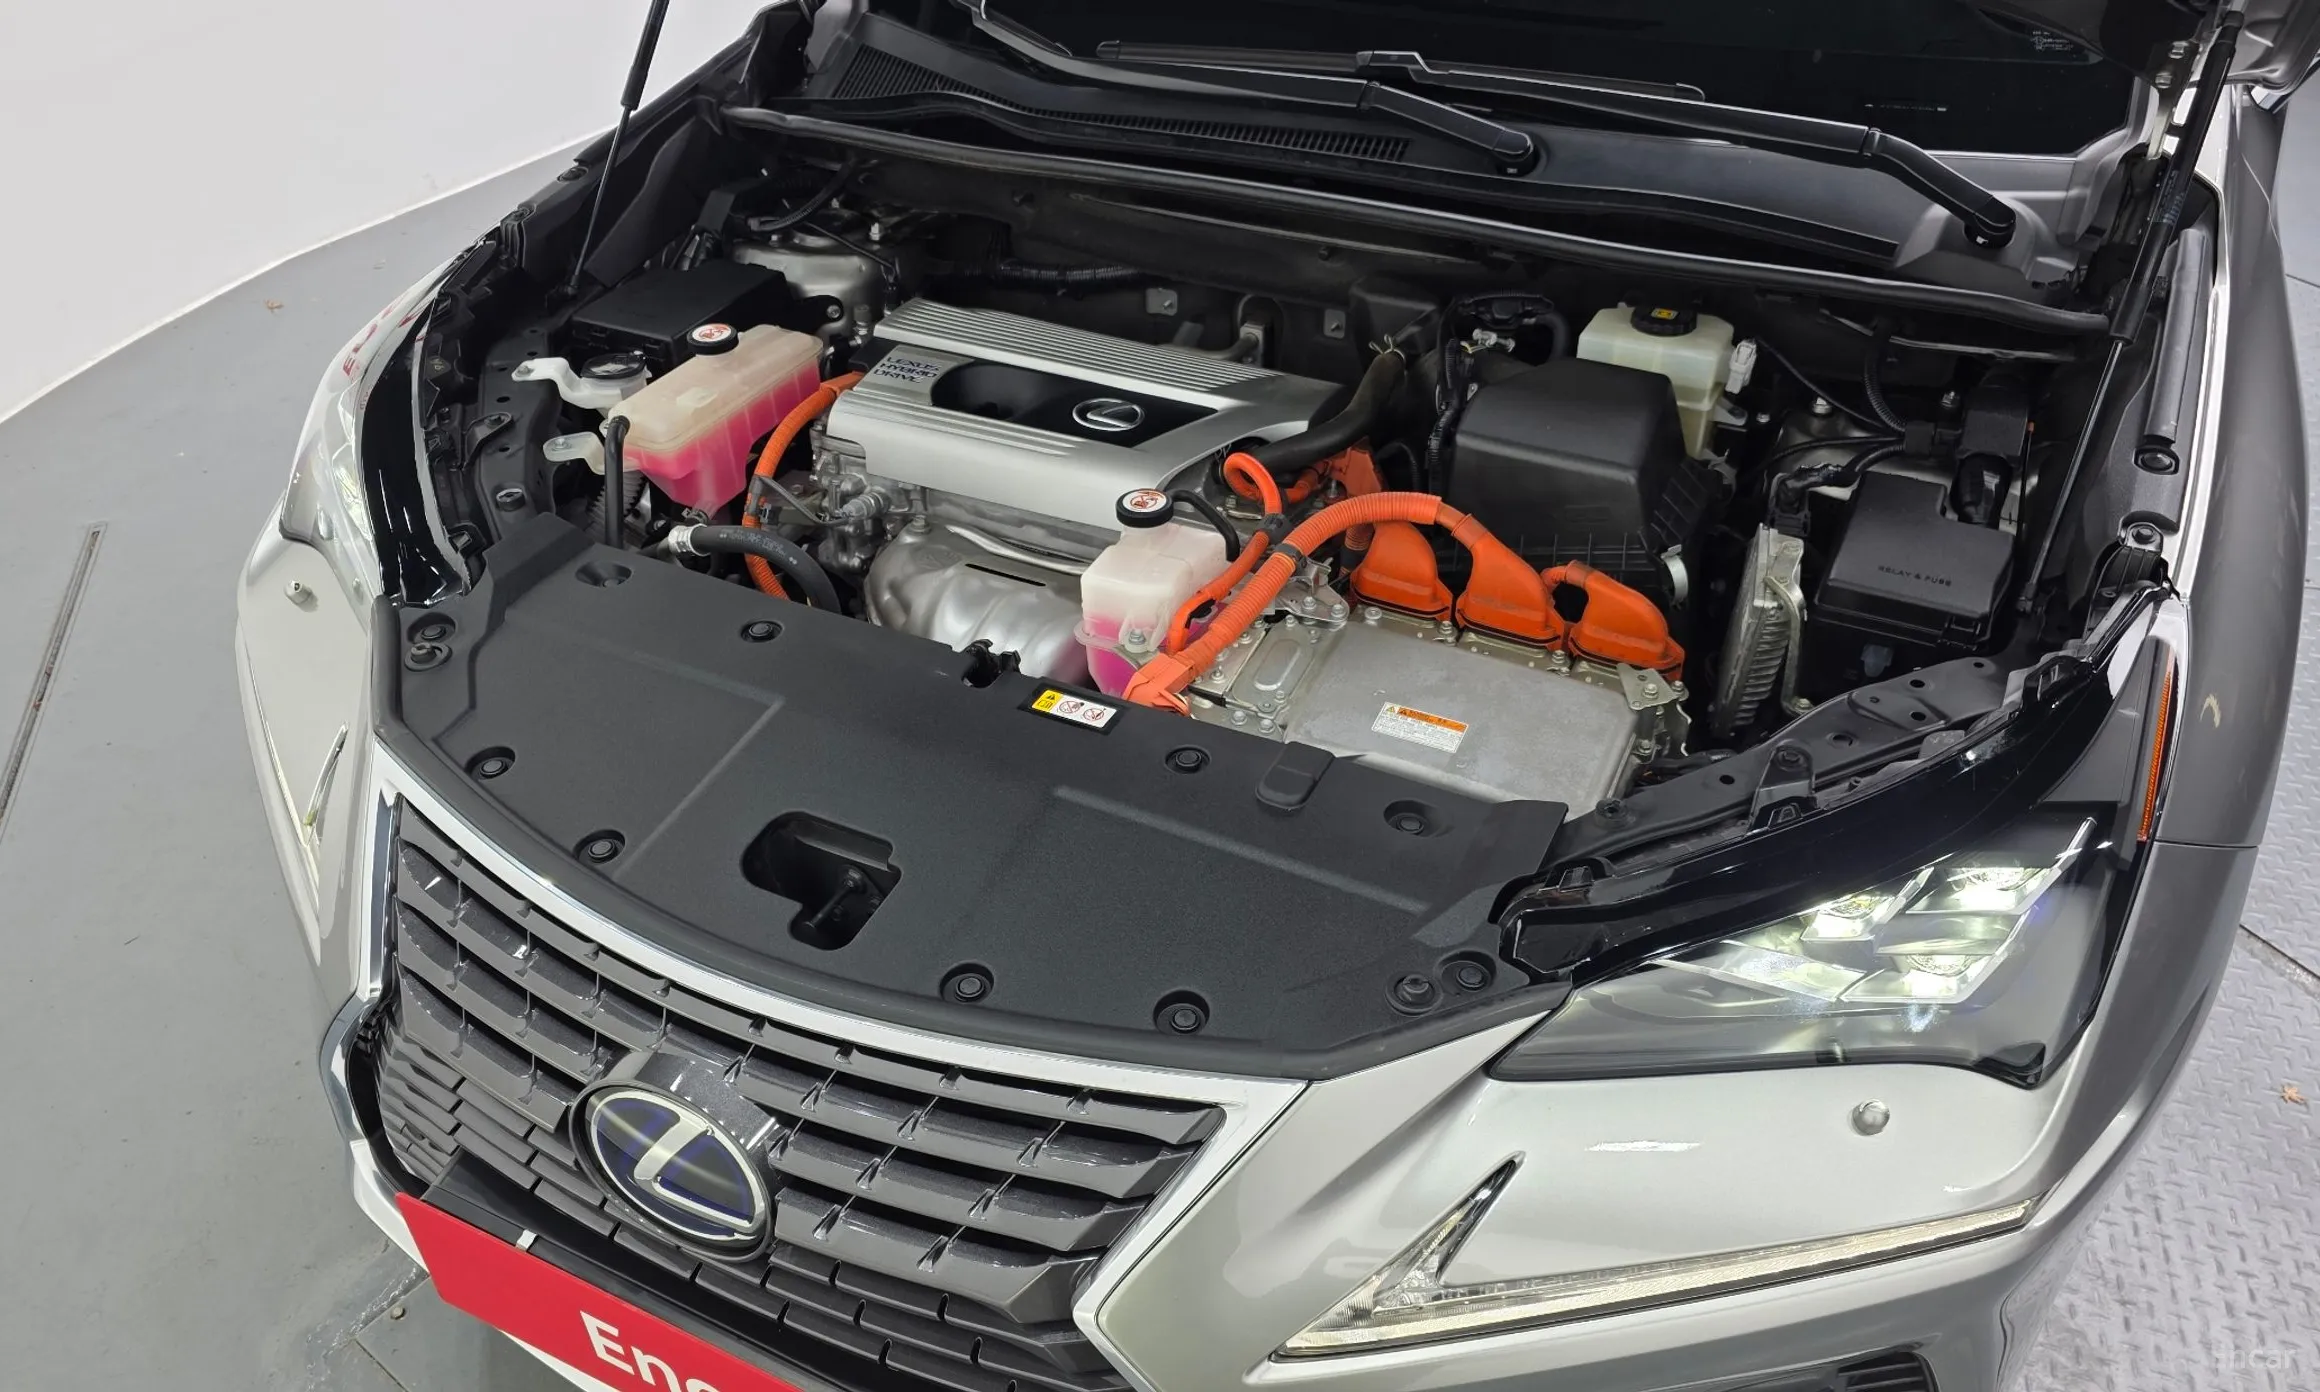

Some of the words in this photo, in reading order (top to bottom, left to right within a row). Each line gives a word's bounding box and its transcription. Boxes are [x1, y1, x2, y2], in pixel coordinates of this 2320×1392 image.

[880, 363, 938, 378] HYBRID
[886, 357, 940, 371] LEXUS
[874, 369, 921, 383] DRIVE
[1878, 565, 1911, 577] RELAY
